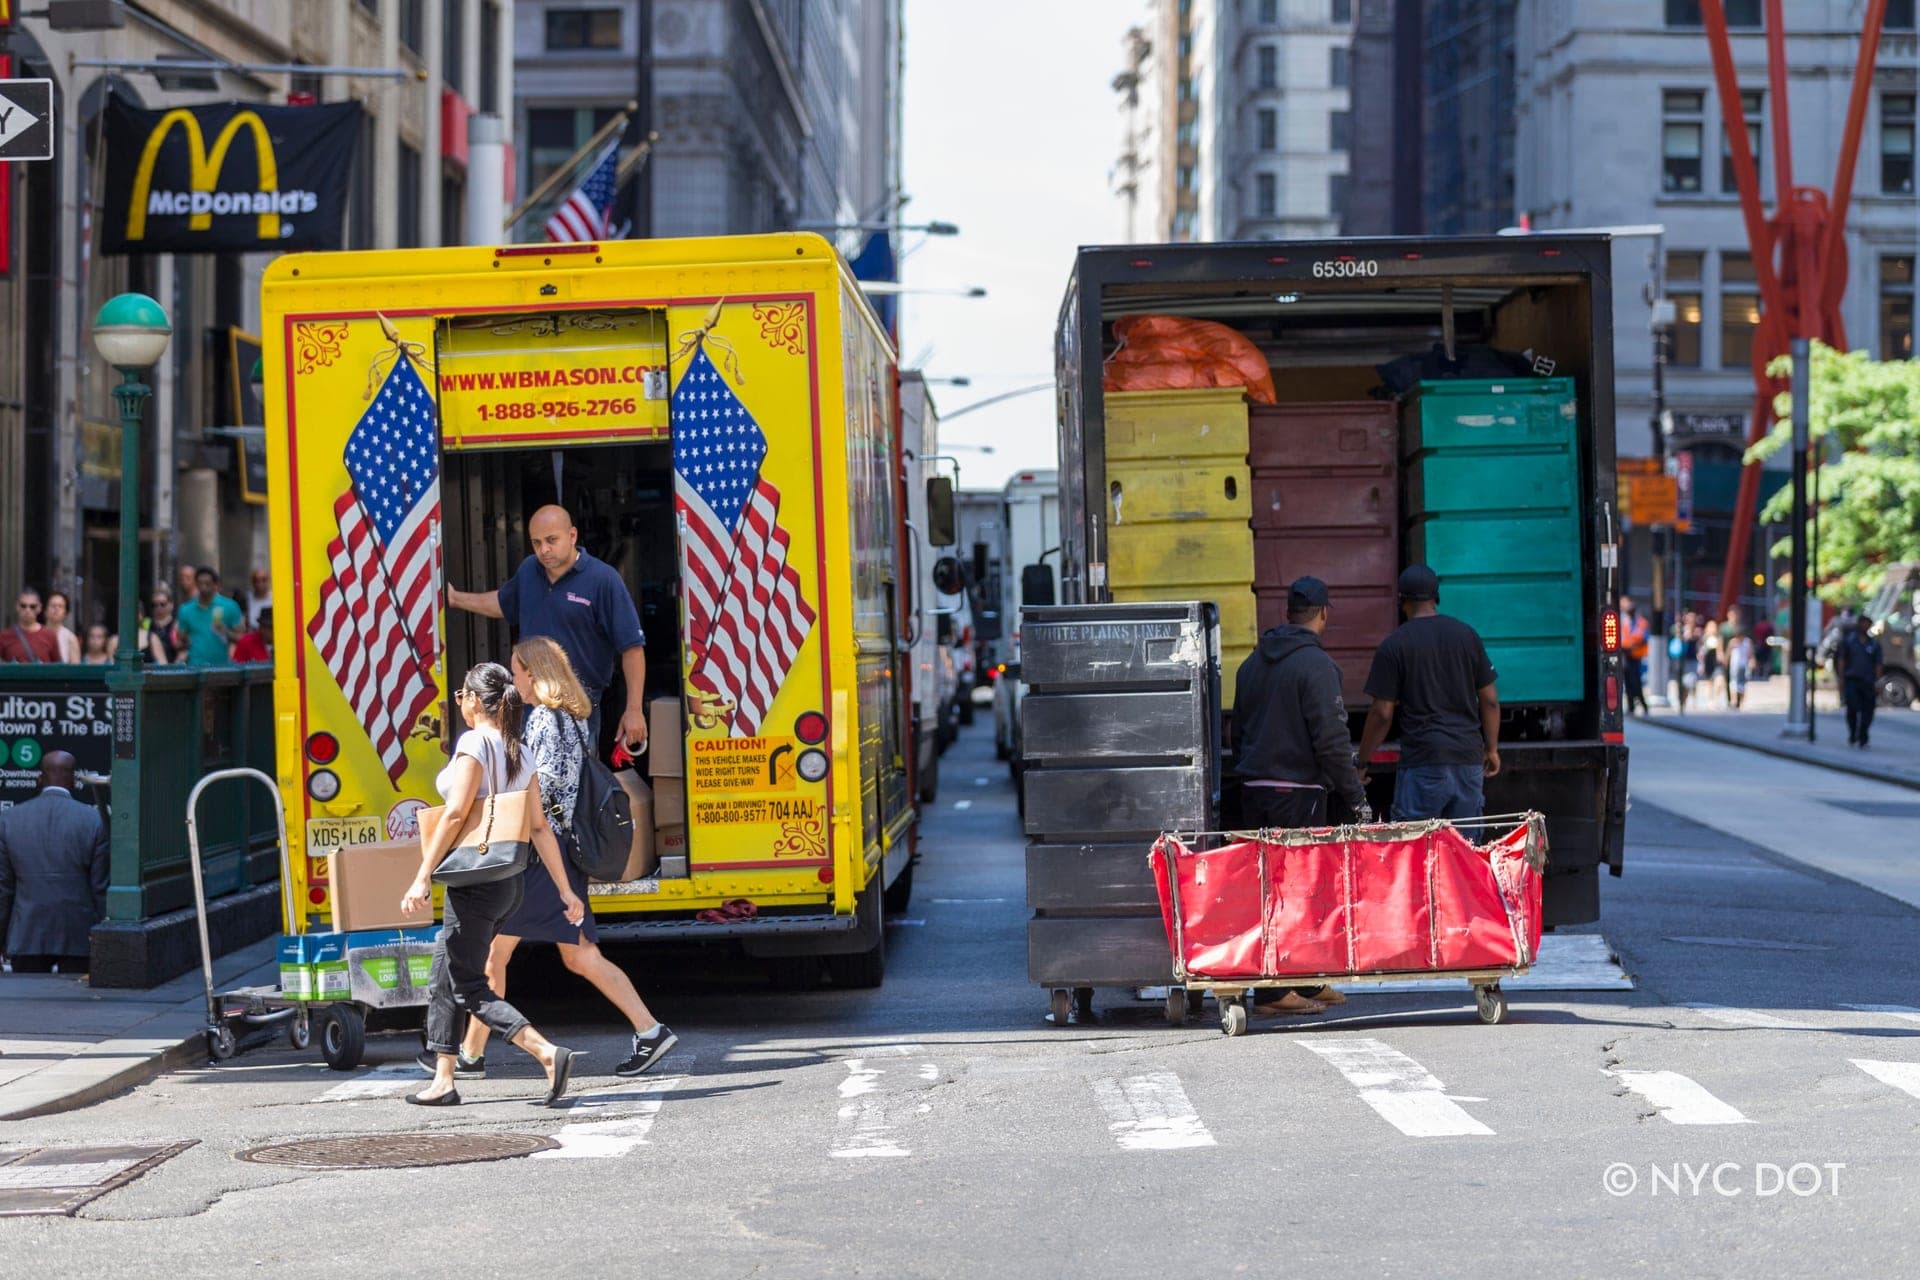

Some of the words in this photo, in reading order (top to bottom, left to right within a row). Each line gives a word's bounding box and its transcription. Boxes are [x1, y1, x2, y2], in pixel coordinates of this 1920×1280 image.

[148, 189, 318, 216] McDonald's
[1312, 259, 1379, 278] 653040
[477, 398, 637, 422] 1-888-926-2766
[1034, 626, 1077, 641] WHITE
[1081, 625, 1130, 640] PLAINS
[66, 695, 96, 720] St
[41, 720, 54, 736] &
[59, 720, 88, 736] The
[20, 744, 33, 762] 5
[694, 738, 767, 752] CAUTION!
[696, 756, 711, 765] THIS
[712, 755, 741, 764] VEHICLE
[742, 754, 767, 763] MAKES
[696, 767, 713, 777] WIDE
[715, 766, 735, 776] RIGHT
[737, 766, 761, 775] TURNS
[6, 780, 37, 788] across
[696, 778, 722, 788] PLEASE
[697, 801, 714, 810] HOW
[716, 801, 727, 810] AM
[733, 800, 766, 809] DRIVING?
[769, 801, 790, 820] 704
[792, 799, 813, 820] AAJ
[696, 809, 767, 824] 1-800-800-9577
